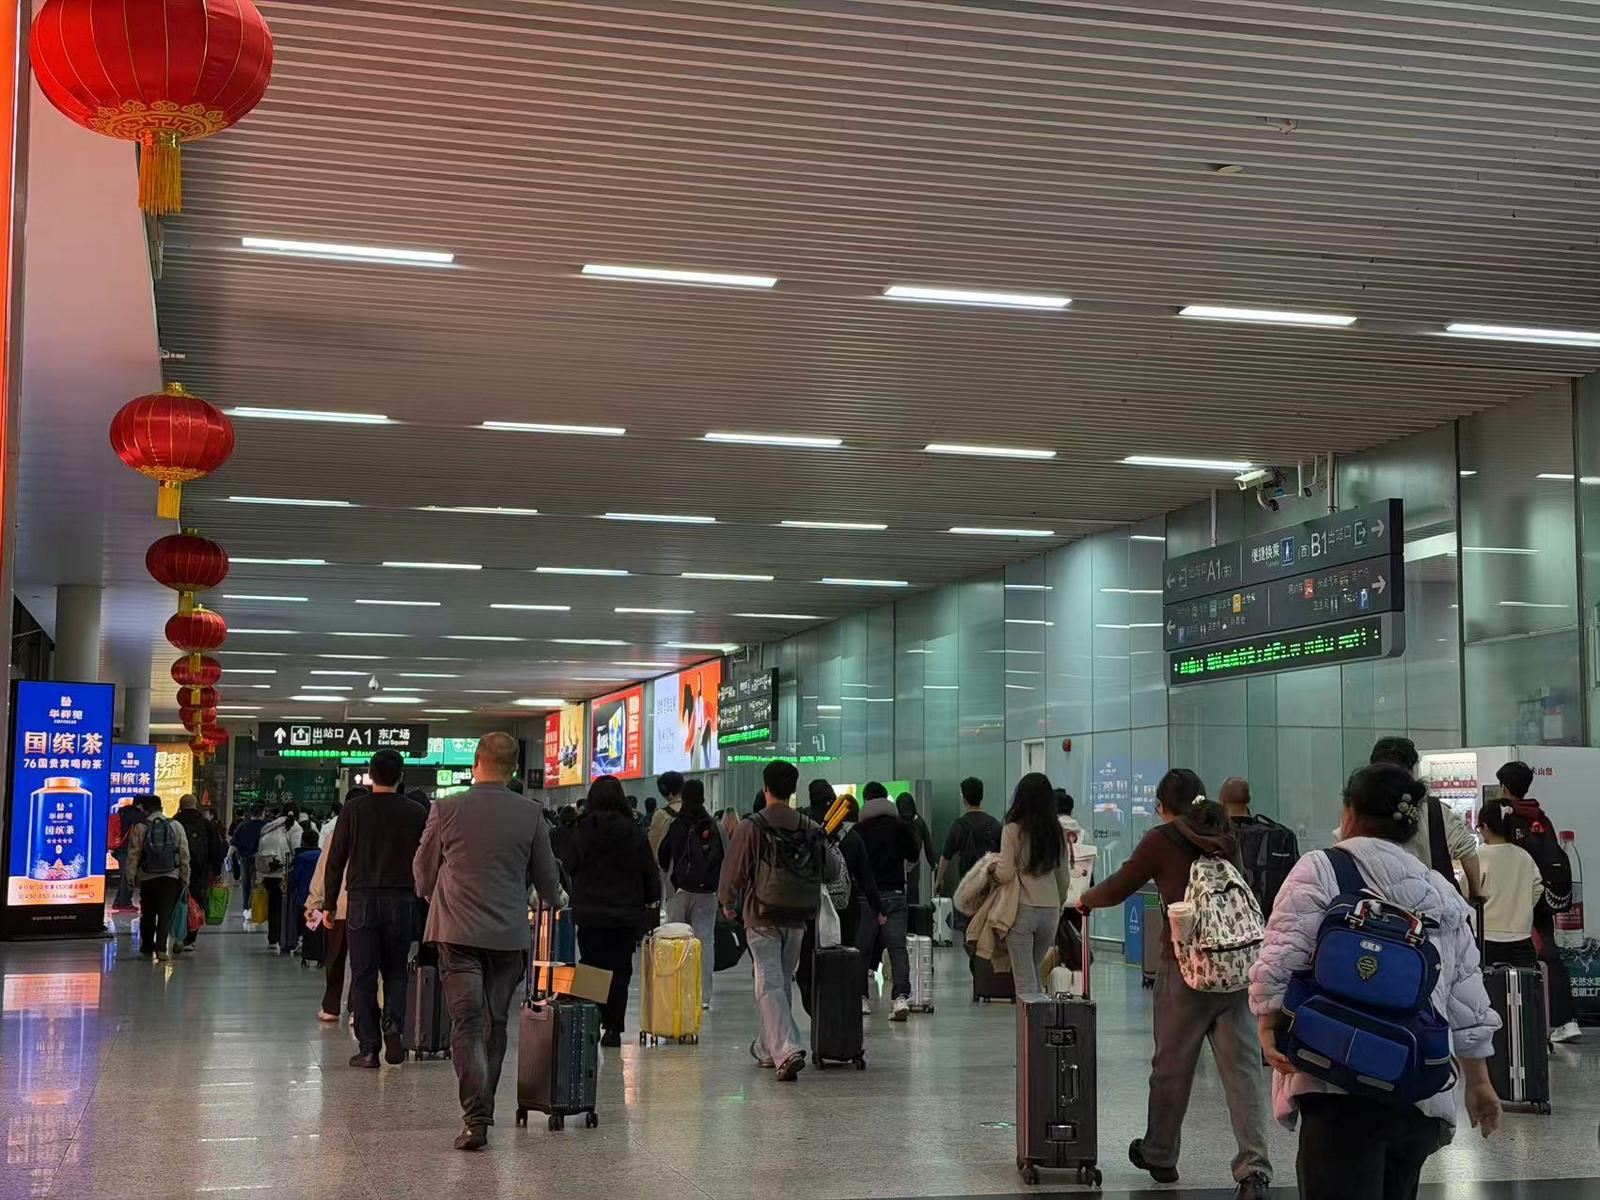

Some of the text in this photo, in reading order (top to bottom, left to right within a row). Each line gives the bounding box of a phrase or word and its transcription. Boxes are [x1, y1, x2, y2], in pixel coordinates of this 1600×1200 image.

[1251, 543, 1280, 563] 便捷换乘
[1311, 531, 1327, 557] B1
[1207, 559, 1220, 582] A1
[313, 727, 344, 739] 出站口
[347, 728, 410, 745] A1 东广场
